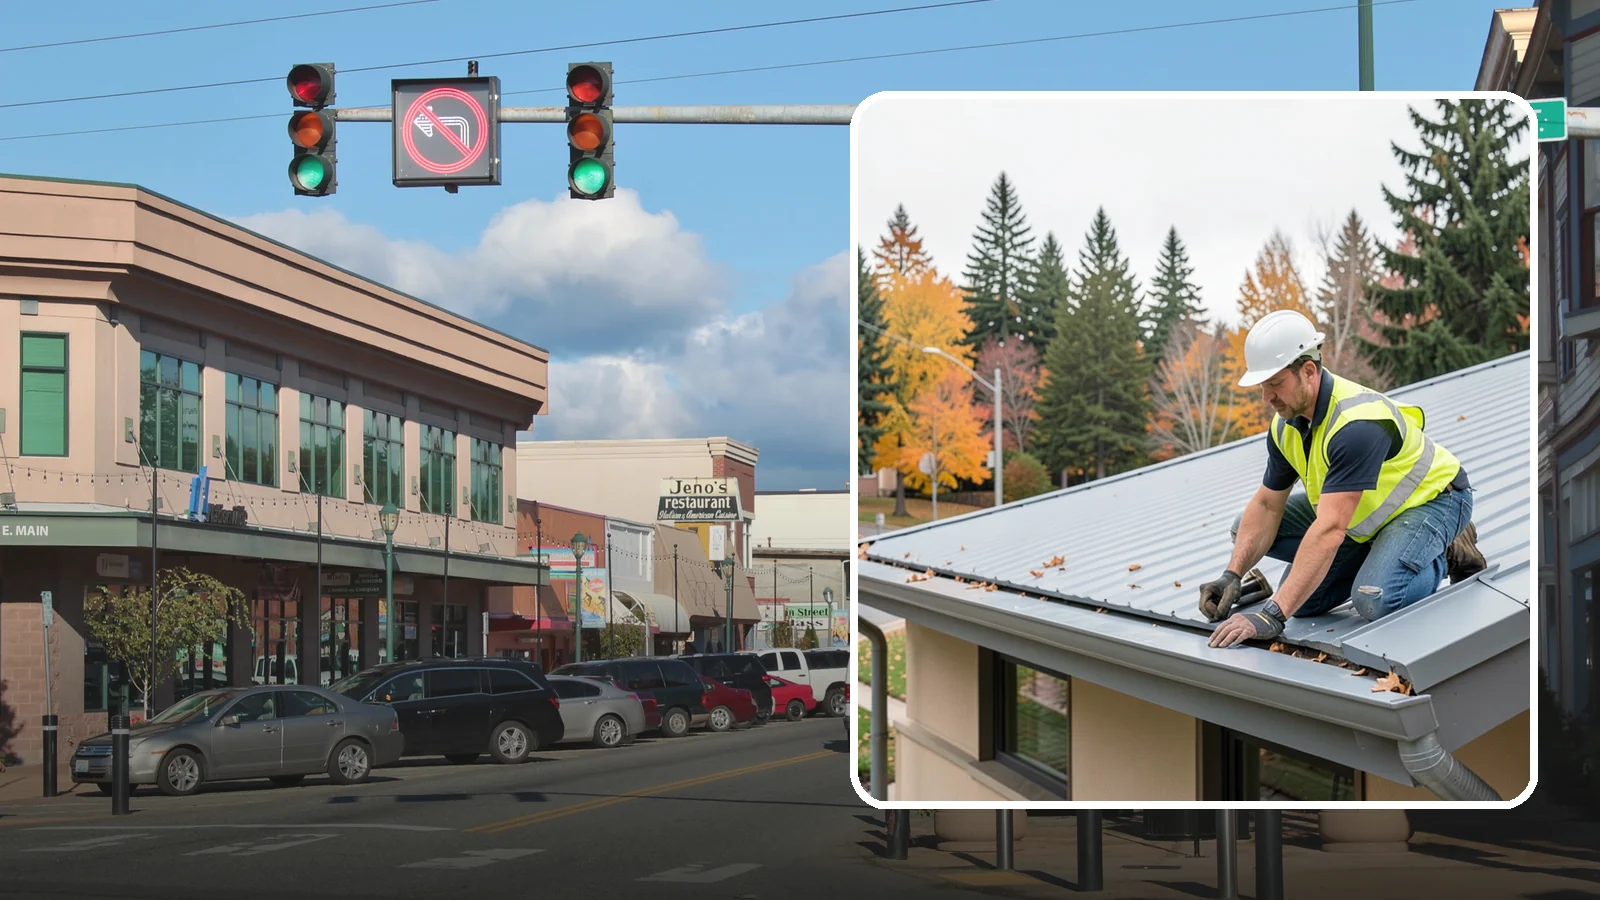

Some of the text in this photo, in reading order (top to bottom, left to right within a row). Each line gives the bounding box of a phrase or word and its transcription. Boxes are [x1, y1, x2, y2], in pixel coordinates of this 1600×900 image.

[670, 480, 727, 494] Jeno's
[665, 497, 731, 508] restaurant
[659, 510, 681, 519] Italian
[686, 509, 714, 519] American
[715, 510, 737, 519] Cuisine
[2, 525, 49, 536] E. MAIN
[797, 607, 828, 617] Street
